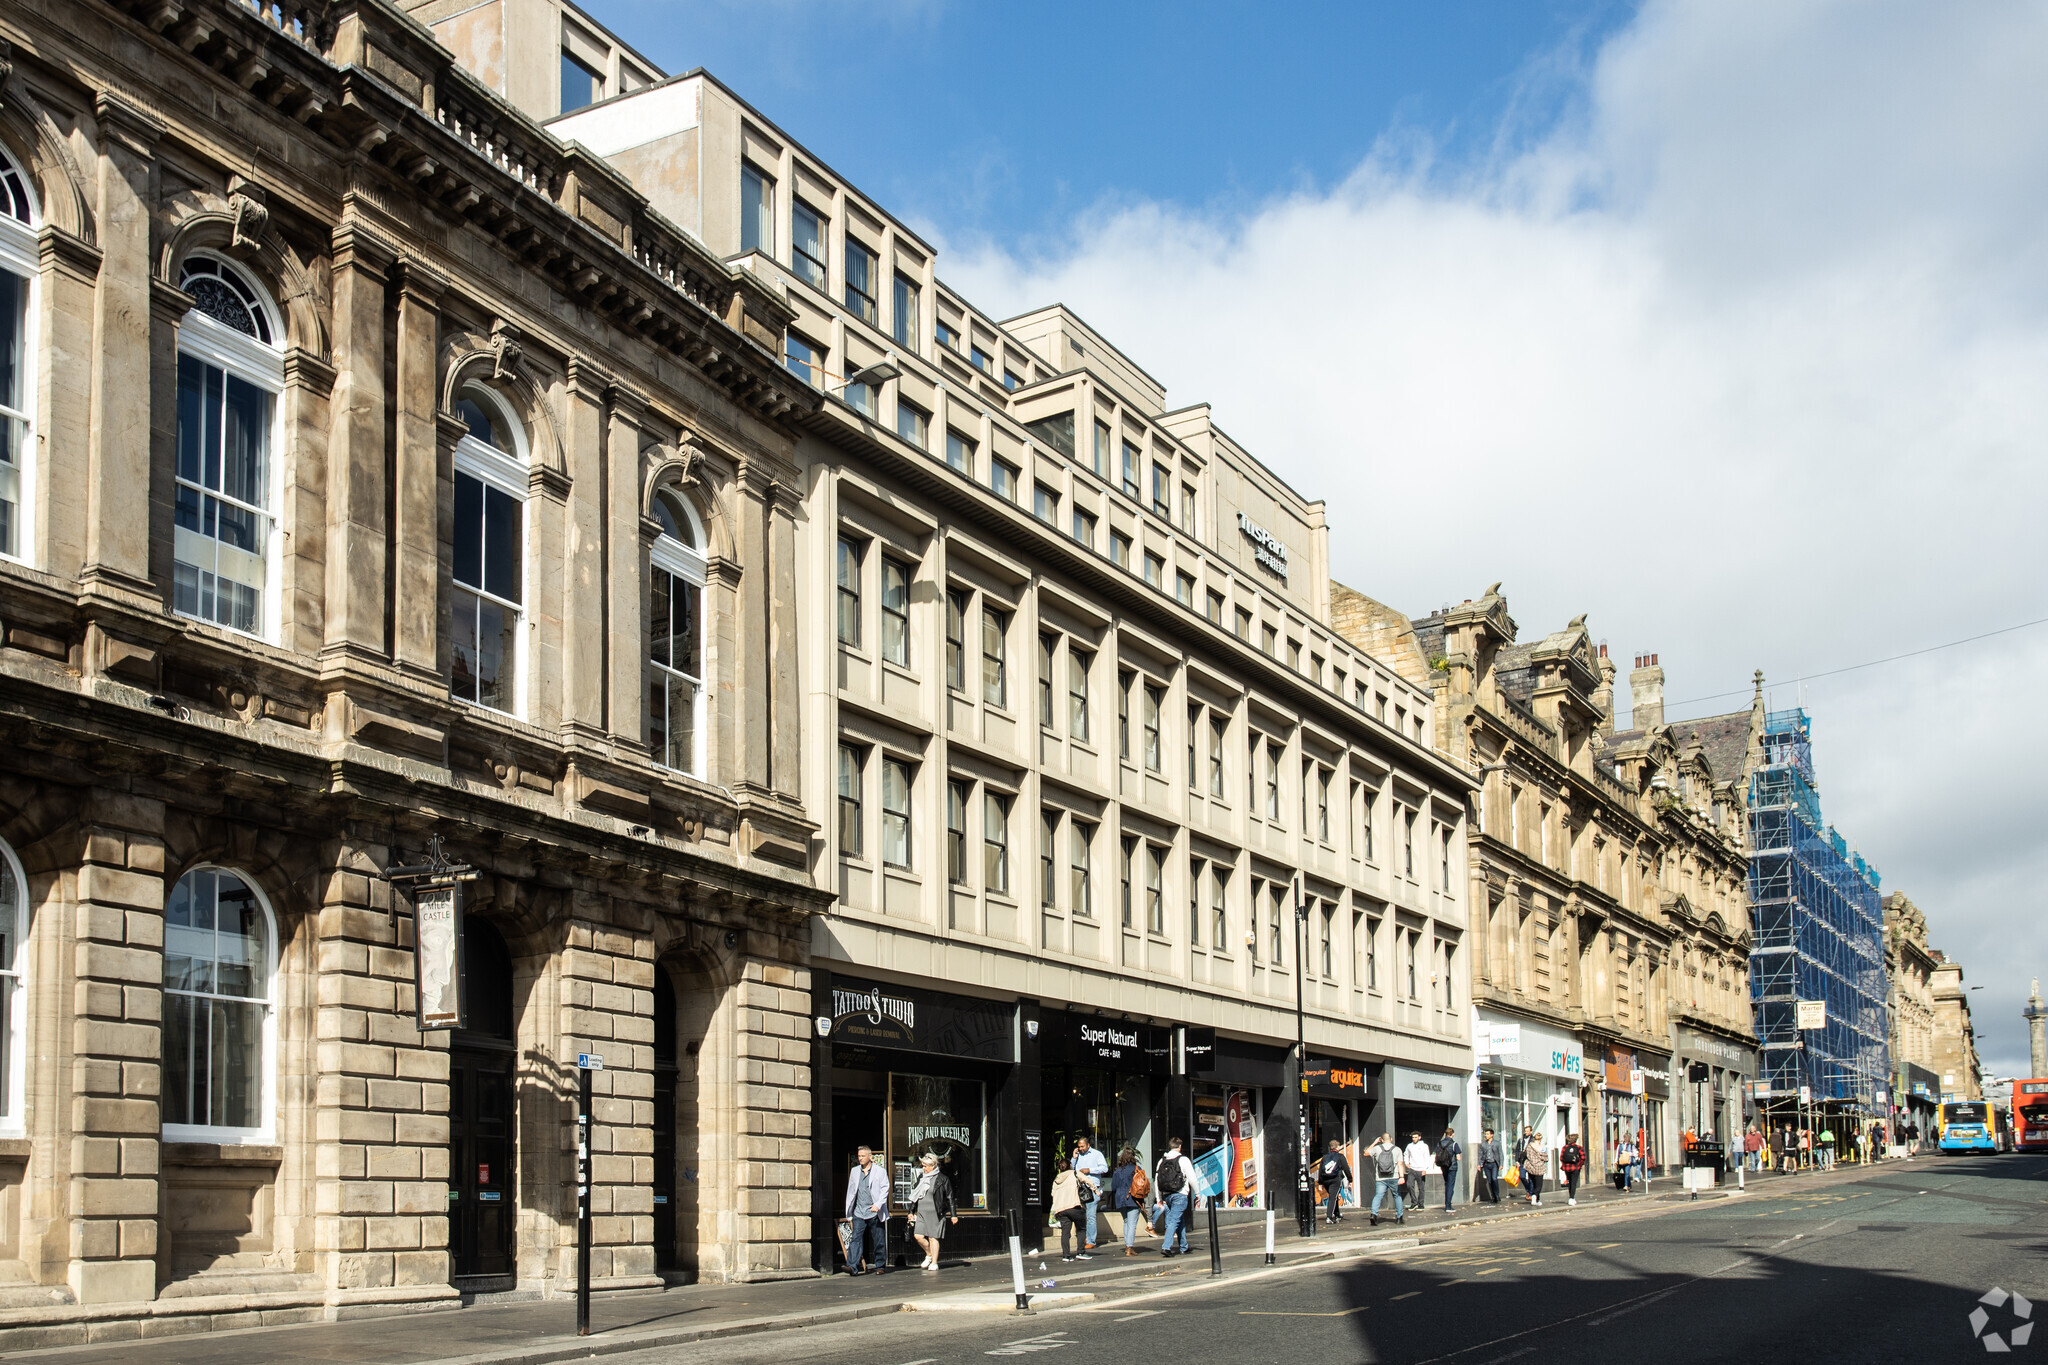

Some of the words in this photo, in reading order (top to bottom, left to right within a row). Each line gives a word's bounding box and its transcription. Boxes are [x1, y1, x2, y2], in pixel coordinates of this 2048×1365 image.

[1237, 510, 1288, 561] TusPark
[423, 911, 450, 921] CASTLE
[427, 901, 445, 910] MILE
[832, 989, 871, 1018] TATTOO
[867, 987, 915, 1029] STUDIO
[1081, 1024, 1107, 1046] Super
[1108, 1028, 1138, 1048] Natural
[1492, 1036, 1518, 1044] savers
[1098, 1048, 1110, 1058] CAFE
[1111, 1049, 1121, 1059] BAR
[1551, 1047, 1580, 1073] savers
[1694, 1038, 1722, 1057] FORBIDDEN
[1723, 1047, 1740, 1062] PLANET
[908, 1126, 924, 1148] PINS
[924, 1126, 939, 1140] AND
[940, 1126, 970, 1147] NEEDLES
